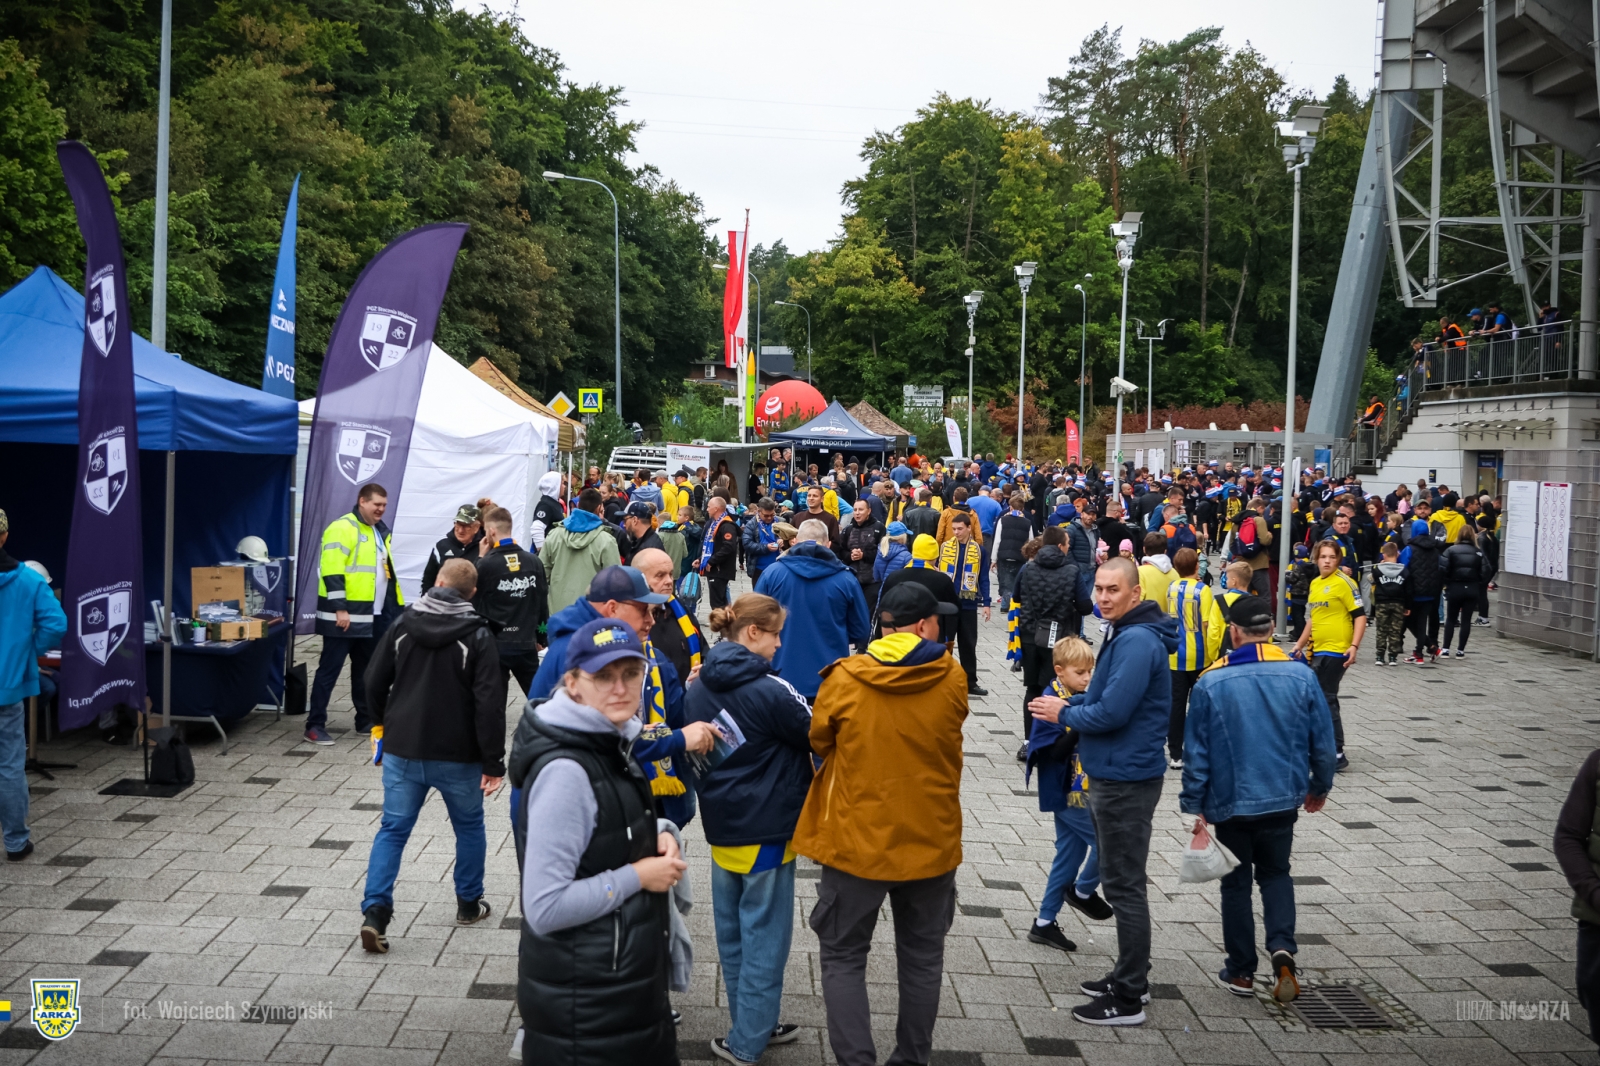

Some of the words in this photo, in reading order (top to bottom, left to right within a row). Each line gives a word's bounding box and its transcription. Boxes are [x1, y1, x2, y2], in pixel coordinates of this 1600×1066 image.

[371, 322, 383, 332] 19
[388, 349, 400, 360] 22
[276, 361, 295, 384] PGZ
[346, 437, 359, 447] 19
[801, 438, 852, 448] gdyniasport.pl
[364, 463, 375, 473] 22
